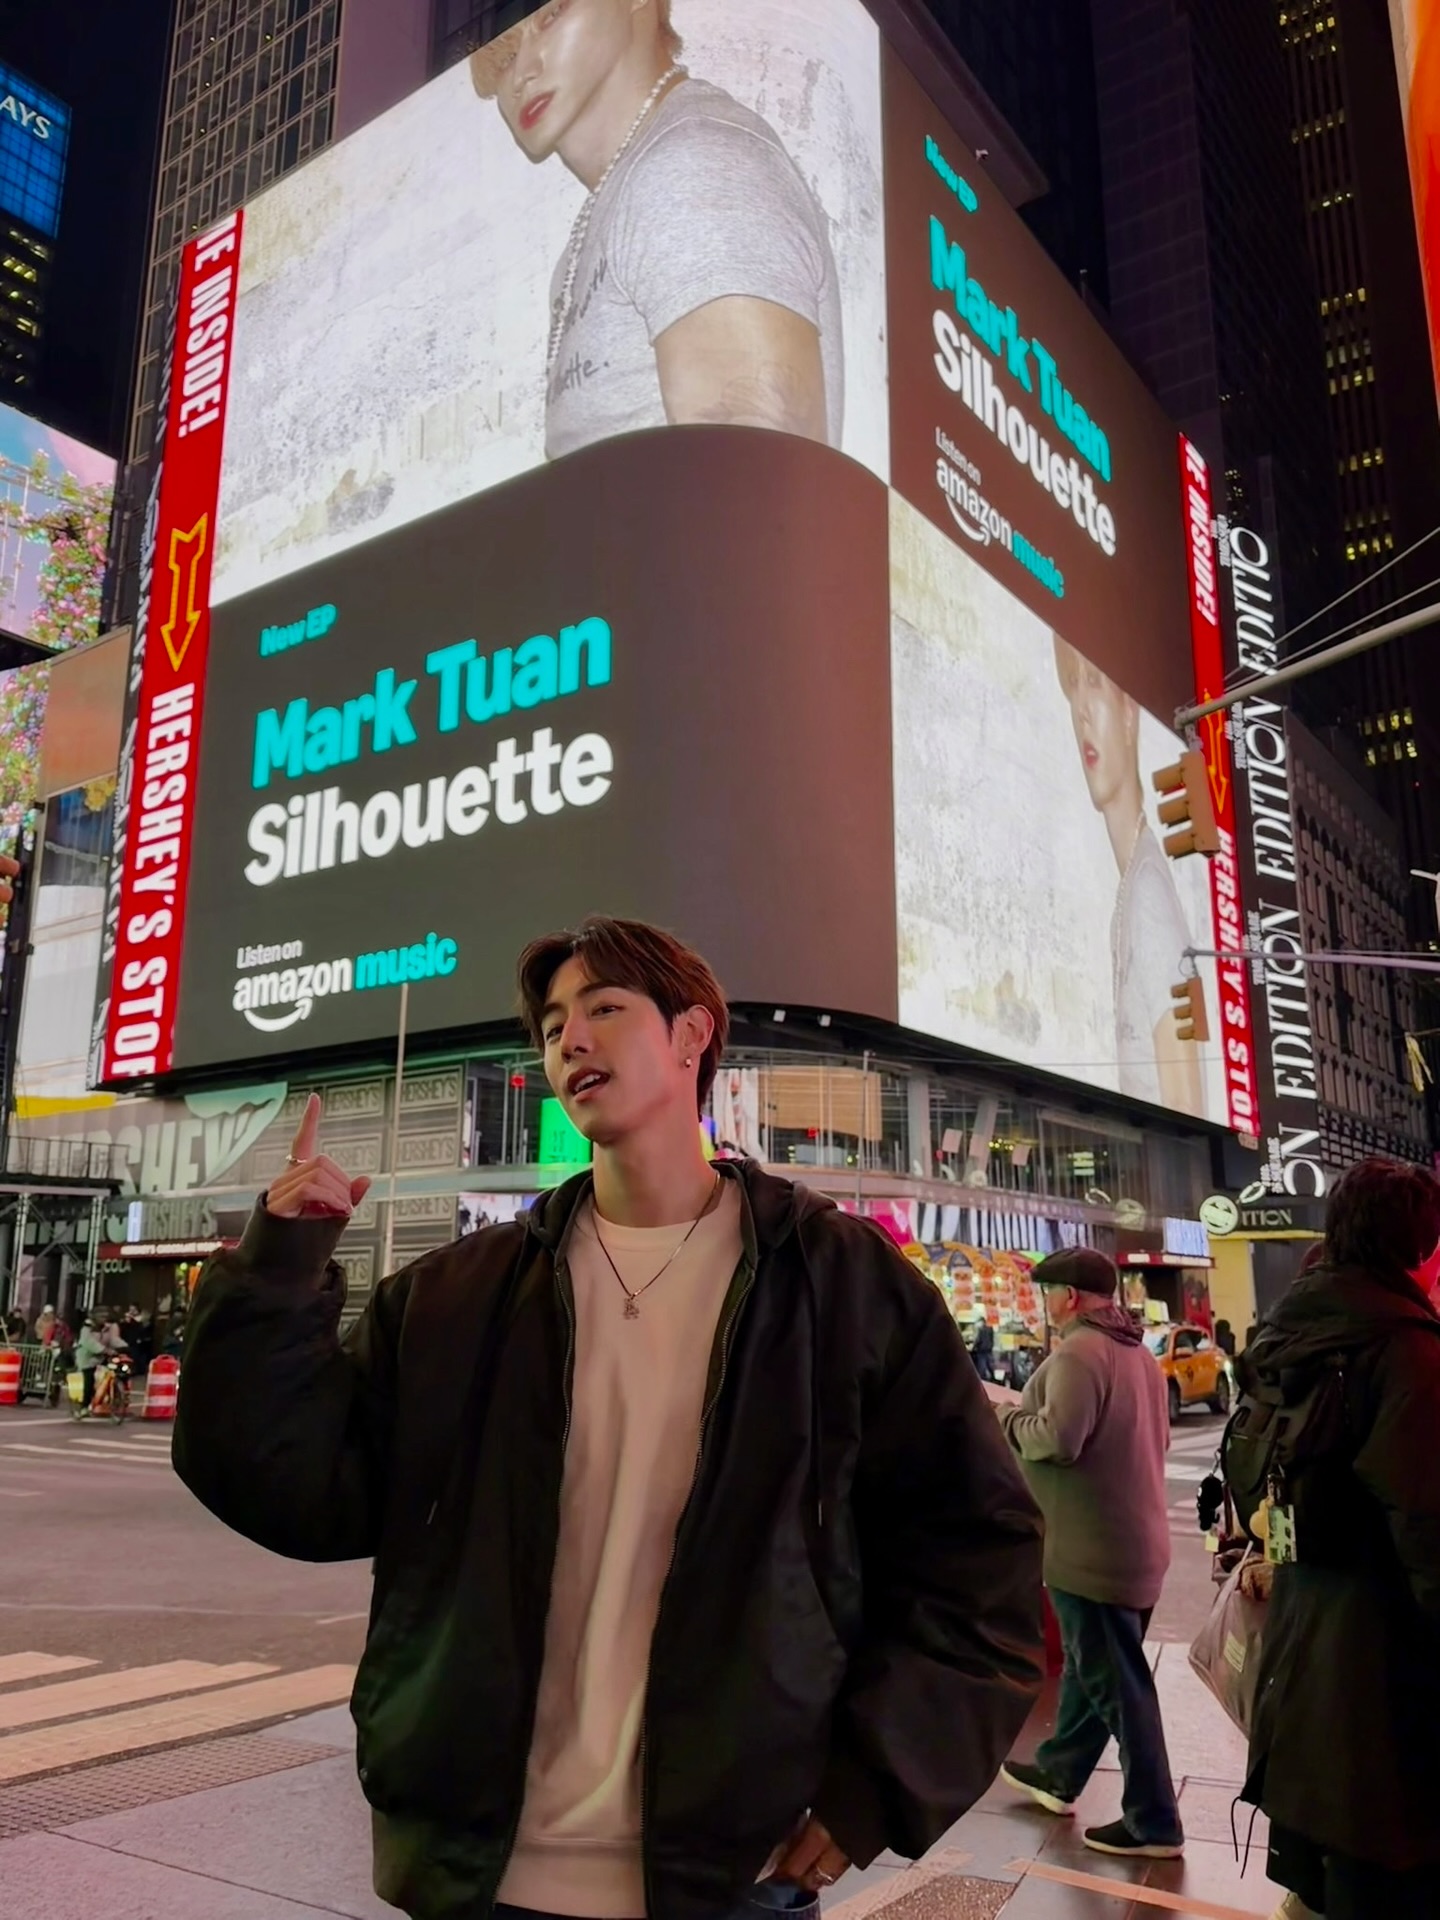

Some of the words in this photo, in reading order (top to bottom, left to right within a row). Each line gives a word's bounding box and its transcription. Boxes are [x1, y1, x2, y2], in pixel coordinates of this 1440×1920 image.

[178, 274, 234, 439] INSIDE!
[929, 214, 1032, 393] Mark
[1031, 338, 1112, 483] Tuan
[932, 309, 1117, 557] Silhouette
[936, 457, 1013, 552] amazon
[1187, 484, 1217, 627] INSIDE!
[251, 667, 418, 789] Mark
[425, 616, 612, 733] Tuan
[259, 620, 305, 657] New
[304, 603, 337, 641] EP
[127, 682, 195, 944] HERSHEY'S
[244, 727, 614, 886] Silhouette
[1243, 696, 1296, 882] EDITION
[232, 957, 352, 1012] amazon
[354, 931, 458, 990] music
[236, 944, 282, 969] Listen
[281, 939, 304, 960] on
[1214, 825, 1248, 1029] HERSHEY'S
[1258, 897, 1319, 1100] EDITION
